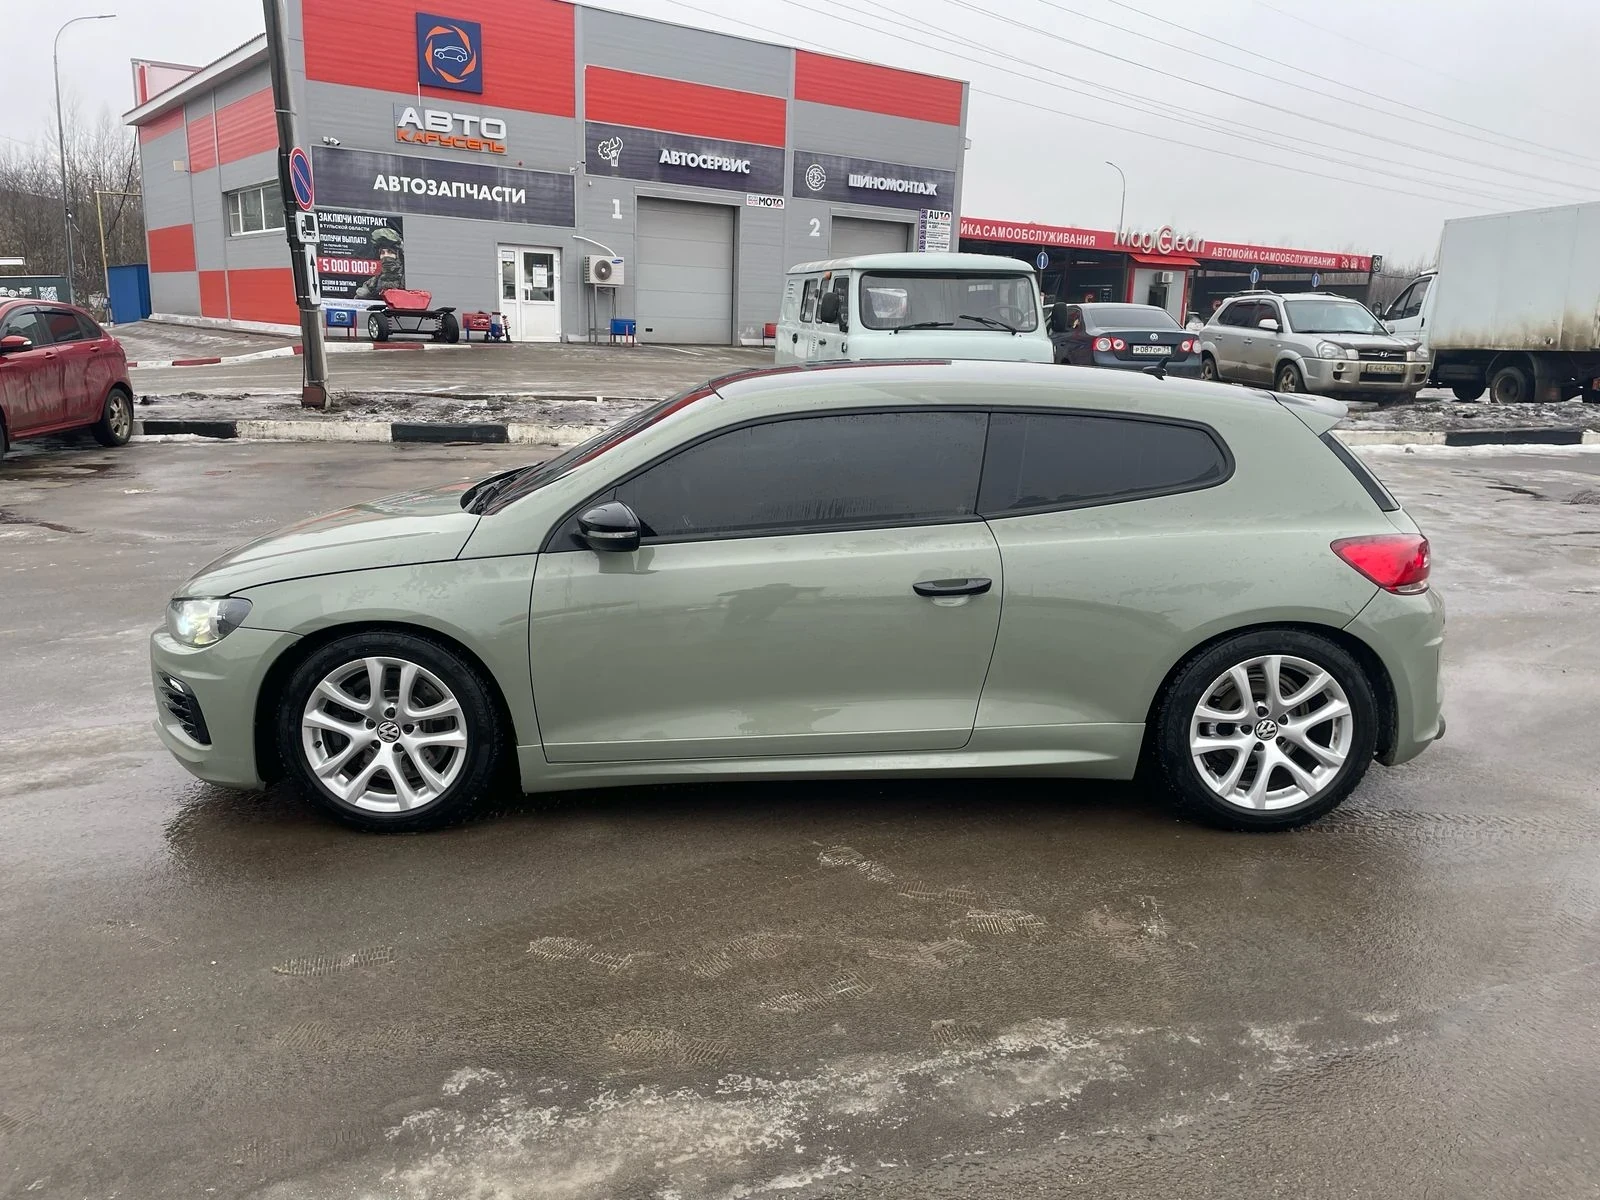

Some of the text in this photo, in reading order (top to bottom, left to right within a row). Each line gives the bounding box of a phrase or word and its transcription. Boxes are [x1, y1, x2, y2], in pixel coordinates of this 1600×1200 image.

[397, 106, 507, 139] АВТО
[396, 130, 506, 154] КАРУСЕЛЬ
[659, 150, 751, 174] АВТОСЕРВИС
[373, 174, 526, 204] АВТОЗАПЧАСТИ
[848, 173, 938, 197] ШИНОМОНТАЖ
[612, 199, 623, 219] 1
[318, 213, 388, 226] ЗАКЛЮЧИ КОНТРАКТ
[809, 218, 821, 237] 2
[320, 234, 366, 244] ПОЛУЧИ ВЫПЛАТУ
[983, 226, 1096, 246] САМООБСЛУЖИВАНИЯ
[332, 260, 350, 272] 000
[1212, 246, 1336, 266] АВТОМОЙКА САМООБСЛУЖИВАНИЯ
